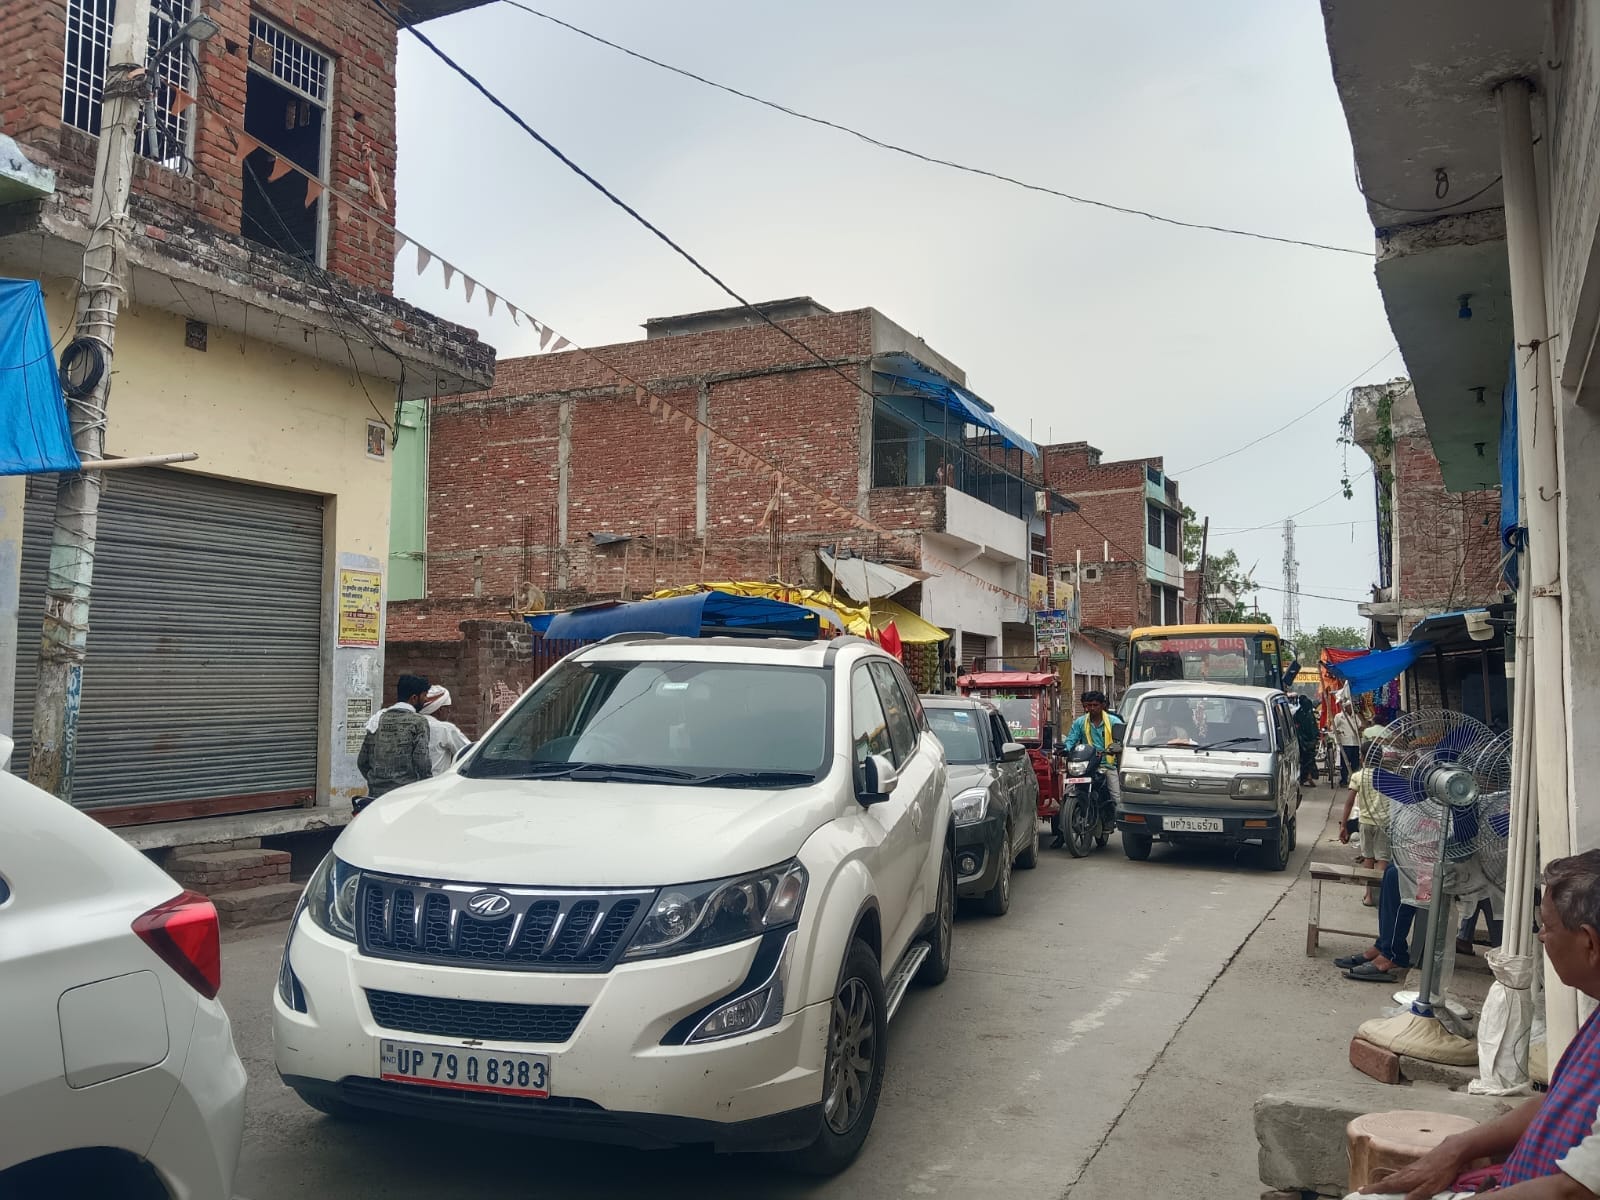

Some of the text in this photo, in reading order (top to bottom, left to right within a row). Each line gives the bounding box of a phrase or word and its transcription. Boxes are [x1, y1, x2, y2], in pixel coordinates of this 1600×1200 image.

[1218, 637, 1245, 650] BUS
[383, 1056, 396, 1064] IND
[397, 1048, 424, 1076] UP
[431, 1052, 458, 1080] 79
[486, 1058, 546, 1089] 8383
